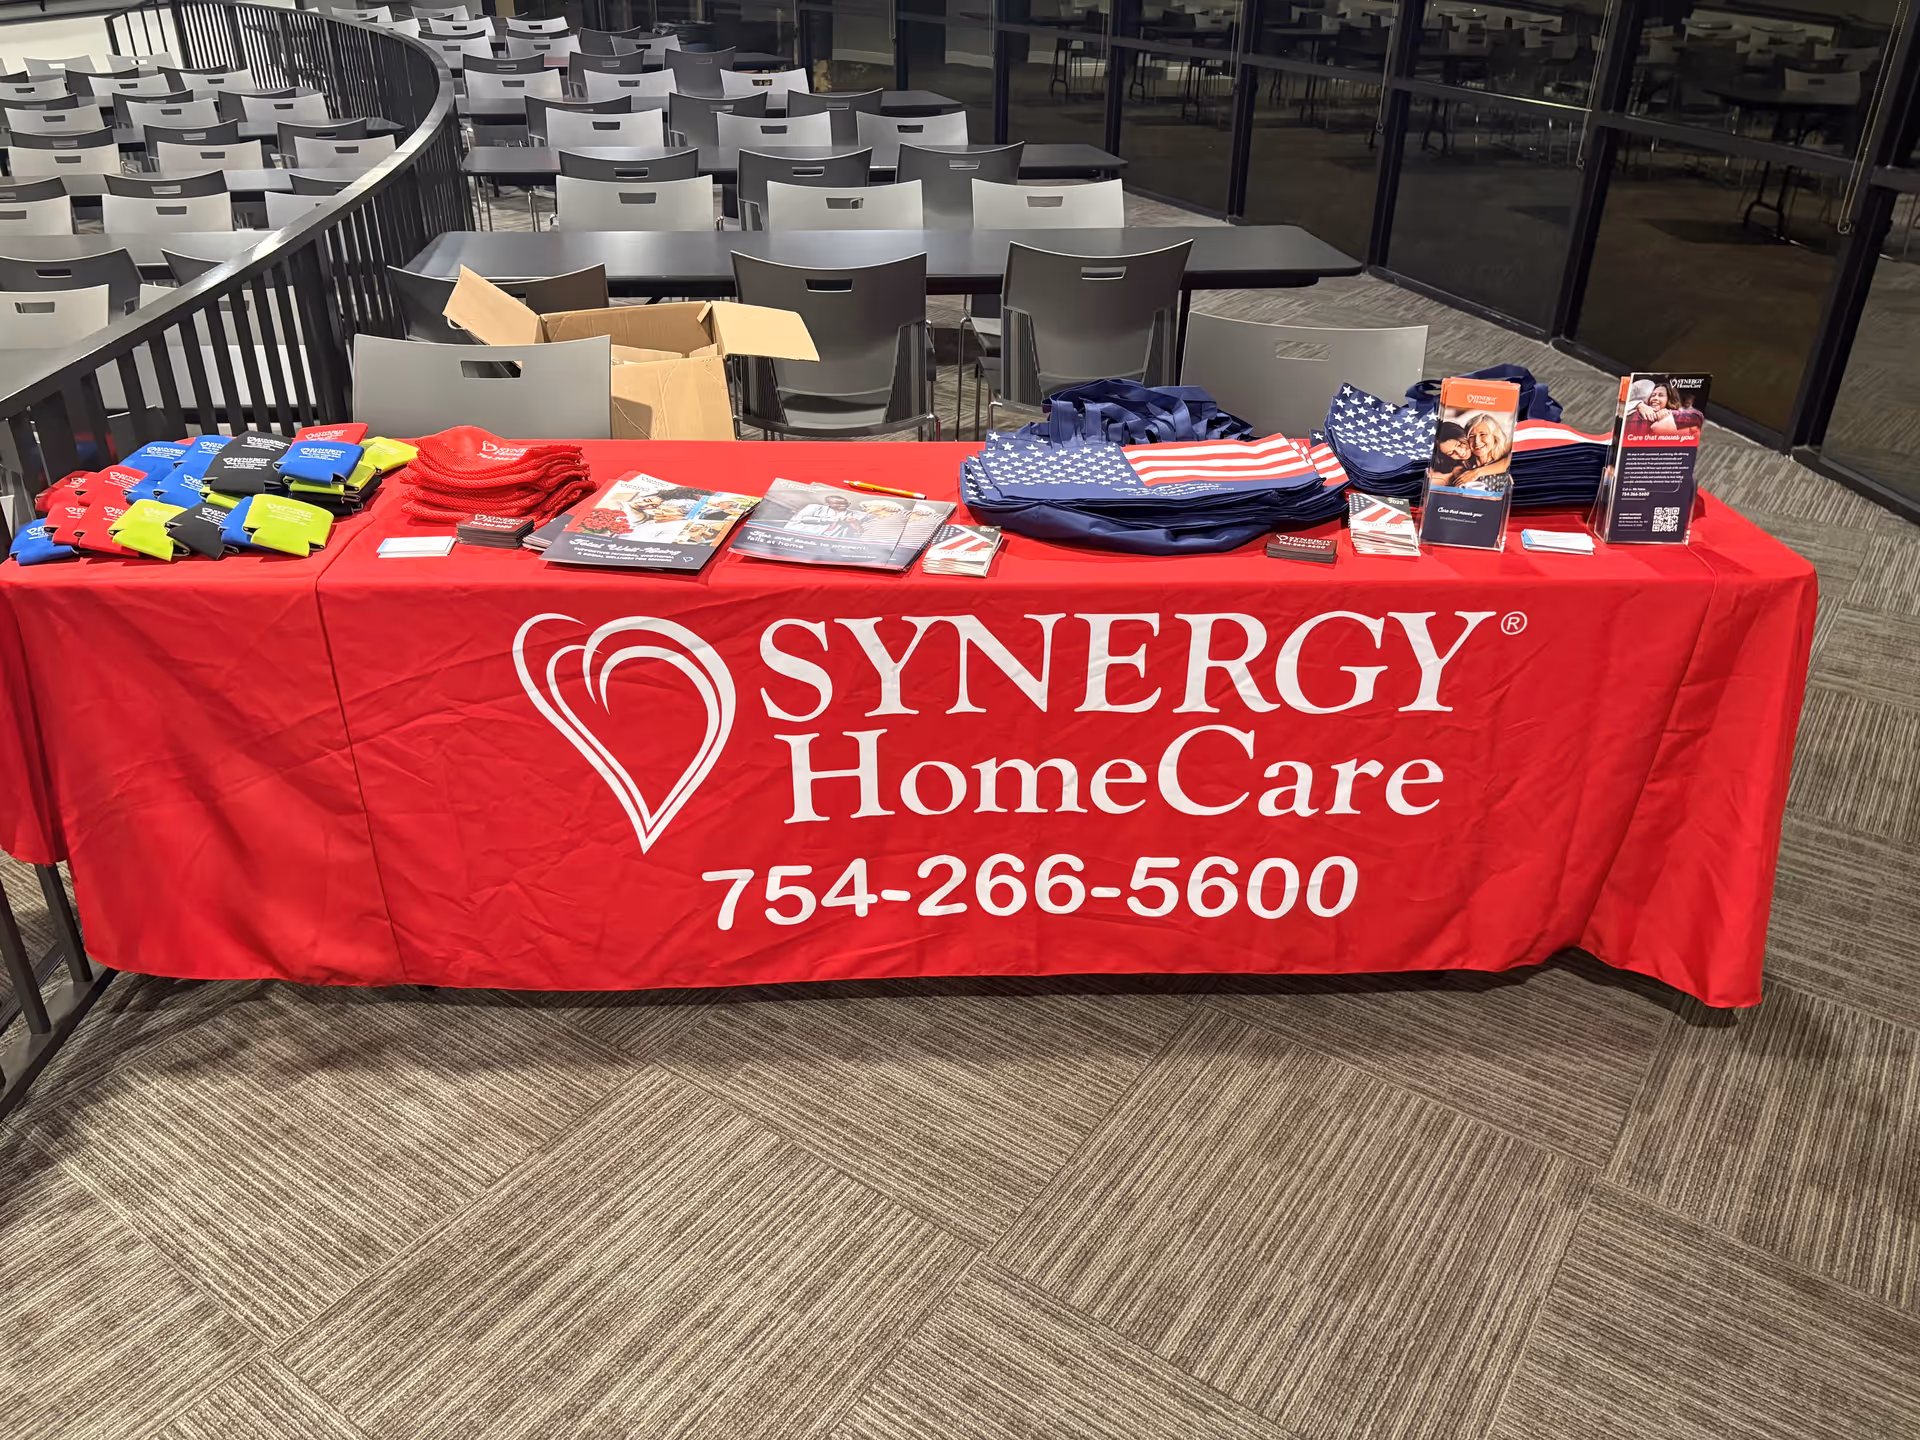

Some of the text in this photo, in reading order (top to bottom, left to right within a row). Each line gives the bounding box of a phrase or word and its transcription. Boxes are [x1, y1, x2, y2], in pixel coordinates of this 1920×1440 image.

[1680, 435, 1695, 443] you
[569, 538, 605, 549] Total
[747, 535, 764, 543] falls
[777, 541, 804, 549] home
[774, 725, 1444, 824] HomeCare
[702, 853, 1359, 931] 754-266-5600
